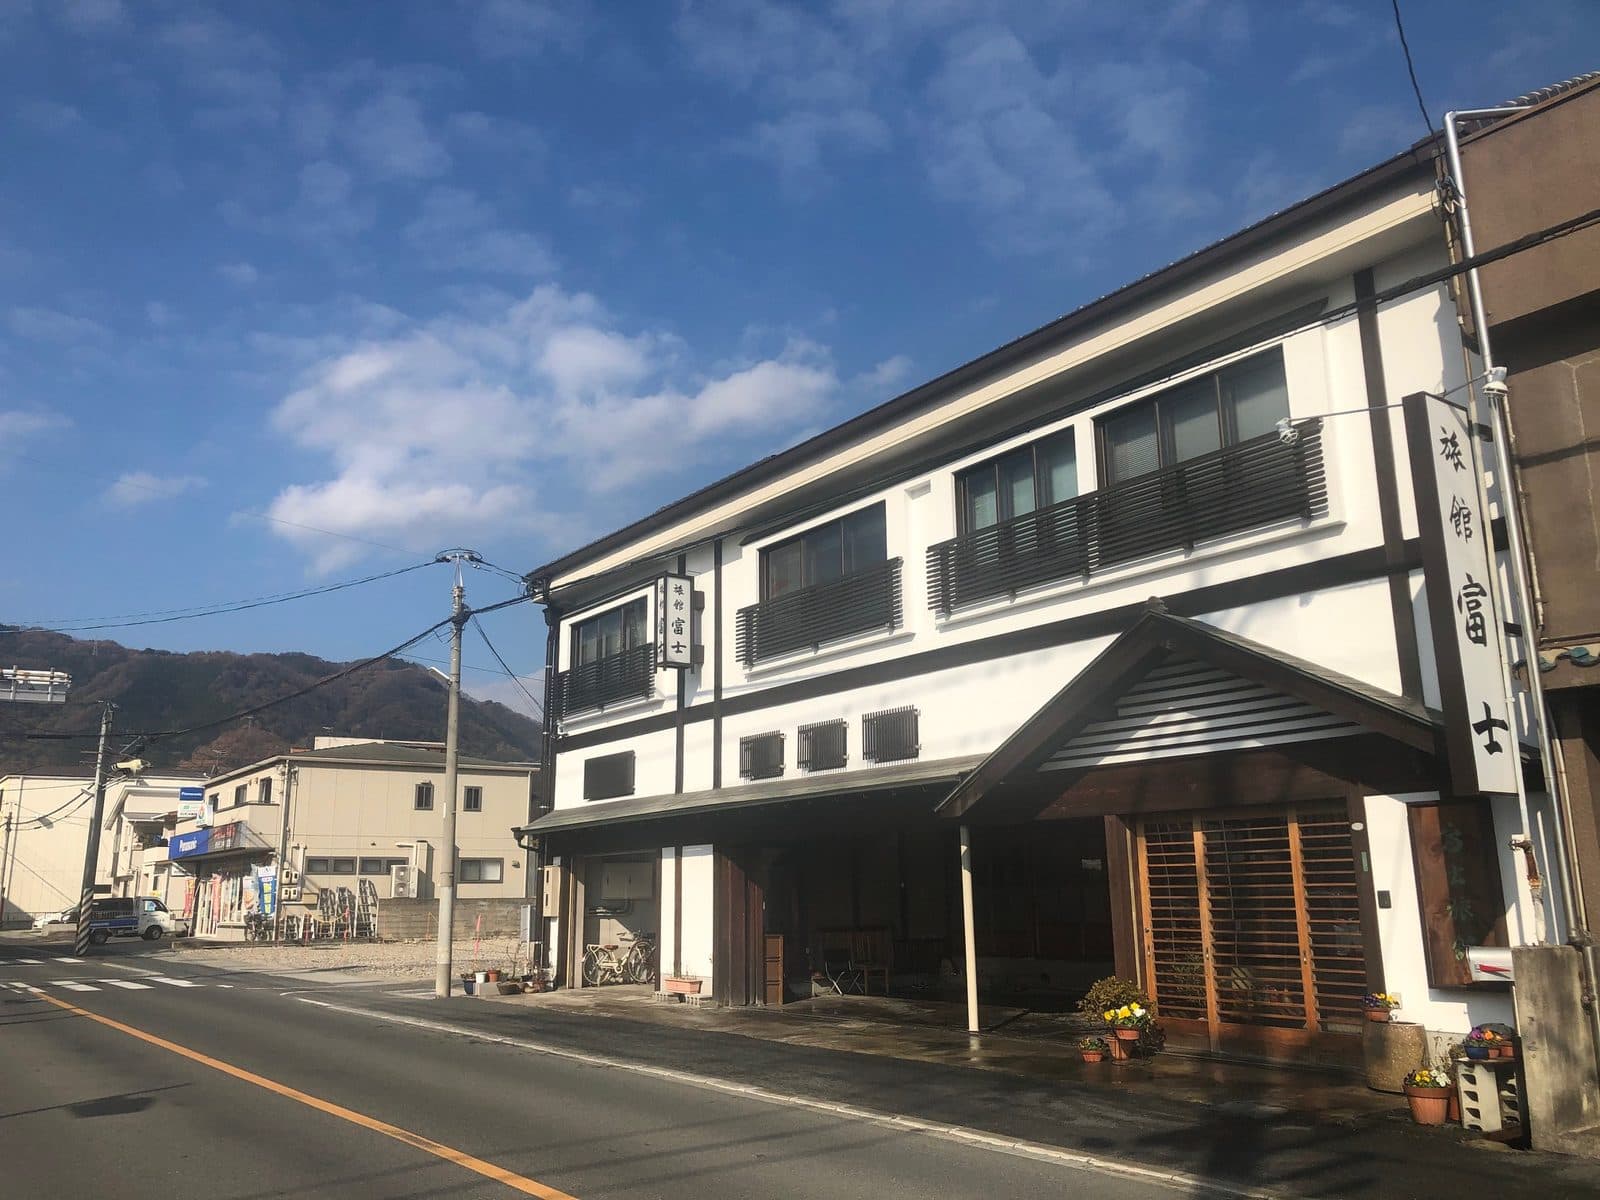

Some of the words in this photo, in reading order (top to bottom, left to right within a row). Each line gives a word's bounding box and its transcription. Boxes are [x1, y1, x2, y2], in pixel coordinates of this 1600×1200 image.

[671, 584, 687, 654] 旅館富士
[1439, 425, 1509, 756] 旅館富士
